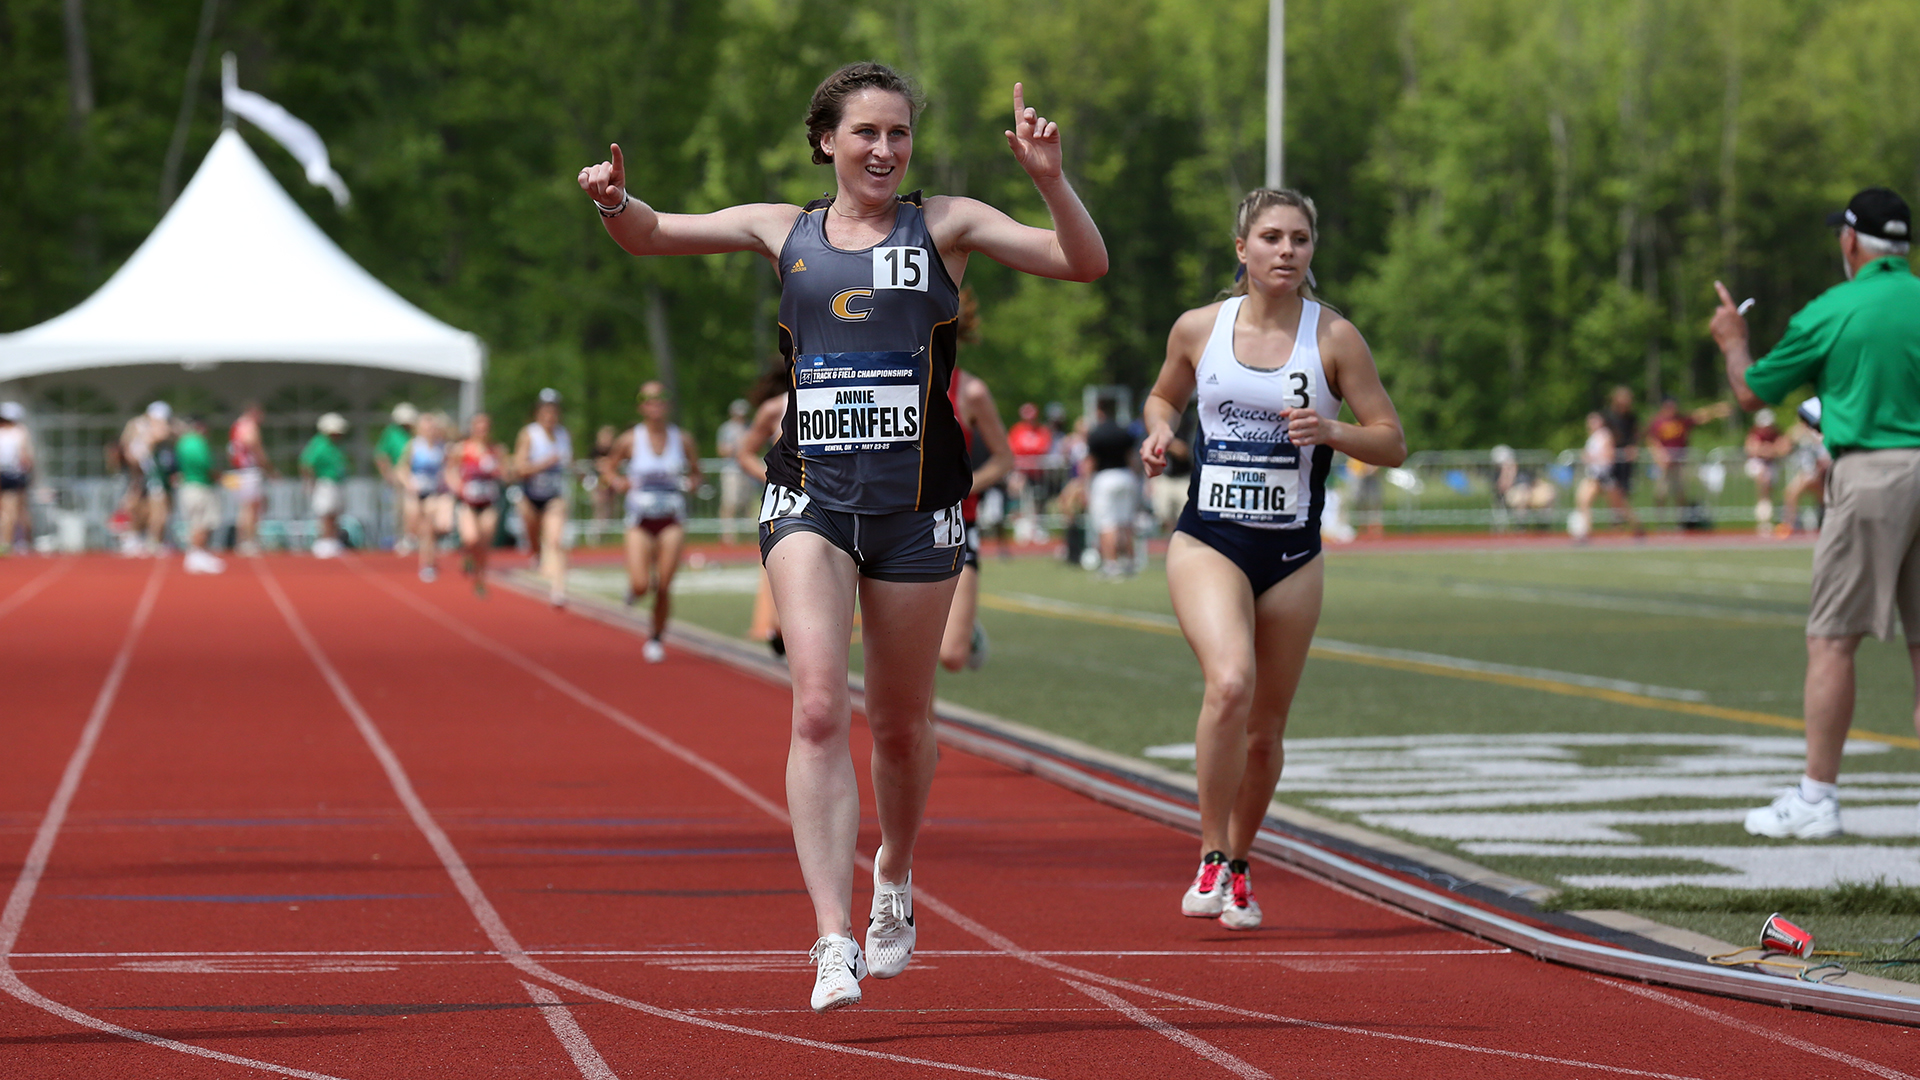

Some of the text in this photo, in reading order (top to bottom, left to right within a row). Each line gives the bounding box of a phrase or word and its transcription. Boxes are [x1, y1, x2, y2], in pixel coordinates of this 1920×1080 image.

[884, 249, 921, 287] 15
[829, 286, 876, 323] C
[813, 371, 832, 380] TRACK
[832, 371, 838, 379] &
[838, 370, 857, 379] FIELD
[857, 369, 913, 379] CHAMPIONSHIPS
[835, 391, 874, 404] ANNIE
[1289, 372, 1310, 409] 3
[799, 406, 917, 440] RODENFELS
[1218, 400, 1285, 422] Geneseo
[1227, 421, 1291, 443] Knight
[1232, 470, 1266, 483] TAYLOR
[771, 485, 802, 516] 15
[1209, 483, 1285, 511] RETTIG
[944, 503, 963, 545] 15
